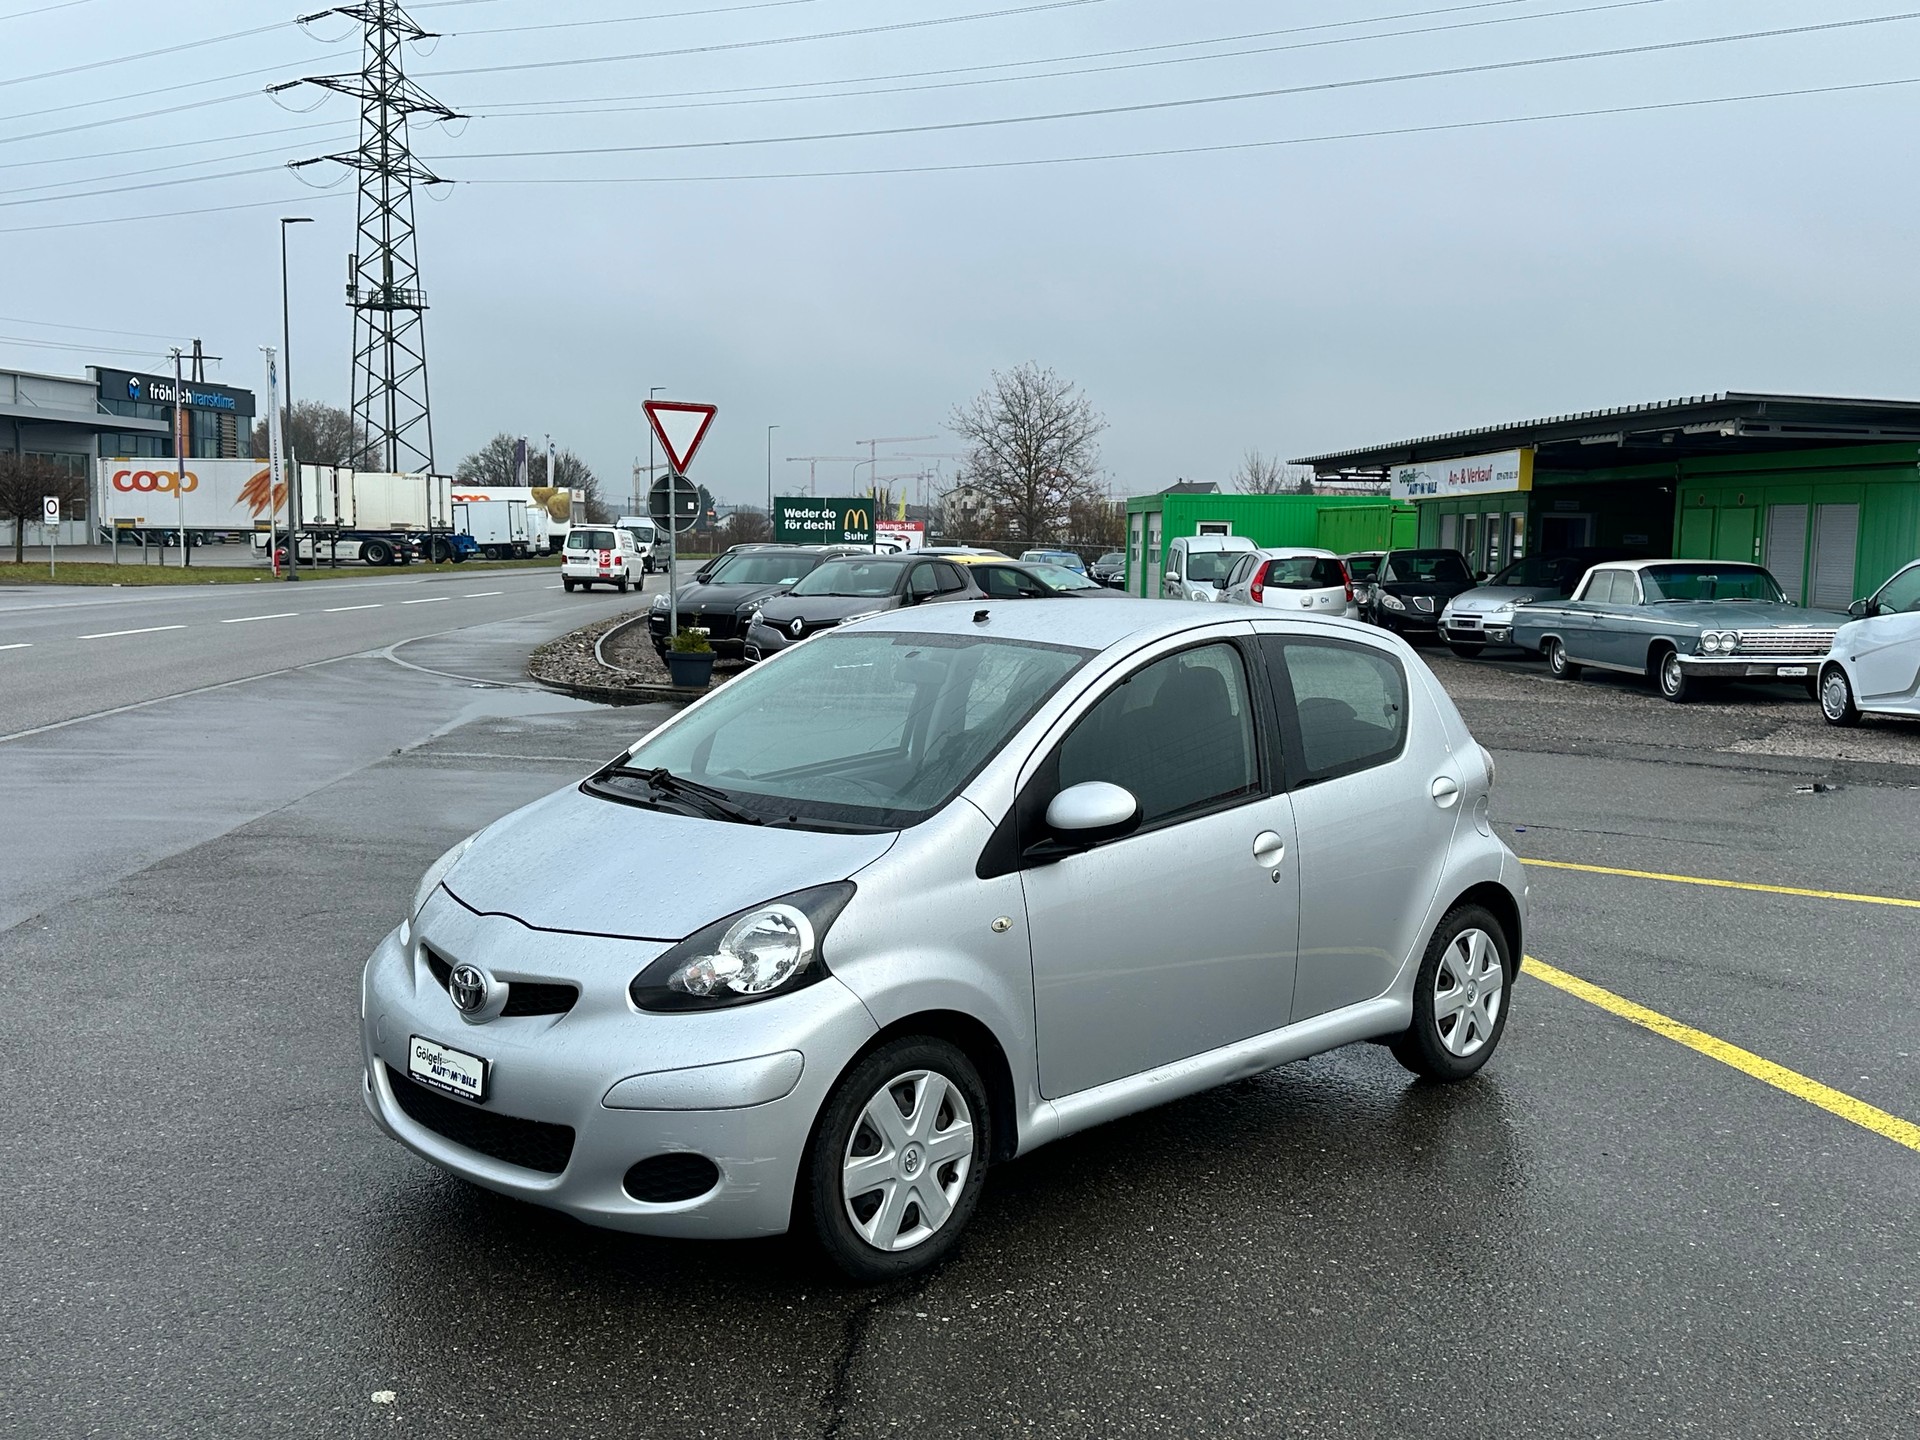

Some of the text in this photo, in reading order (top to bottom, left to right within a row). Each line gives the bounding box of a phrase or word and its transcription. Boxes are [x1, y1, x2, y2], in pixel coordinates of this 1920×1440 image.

[149, 383, 235, 410] fröhlchtransklima
[1460, 468, 1466, 484] &
[1467, 464, 1493, 484] Verkauf
[112, 470, 198, 498] coop
[784, 508, 836, 519] Weder do
[784, 519, 836, 530] för dech!
[844, 532, 869, 541] Suhr
[416, 1046, 442, 1065] Gölgeli
